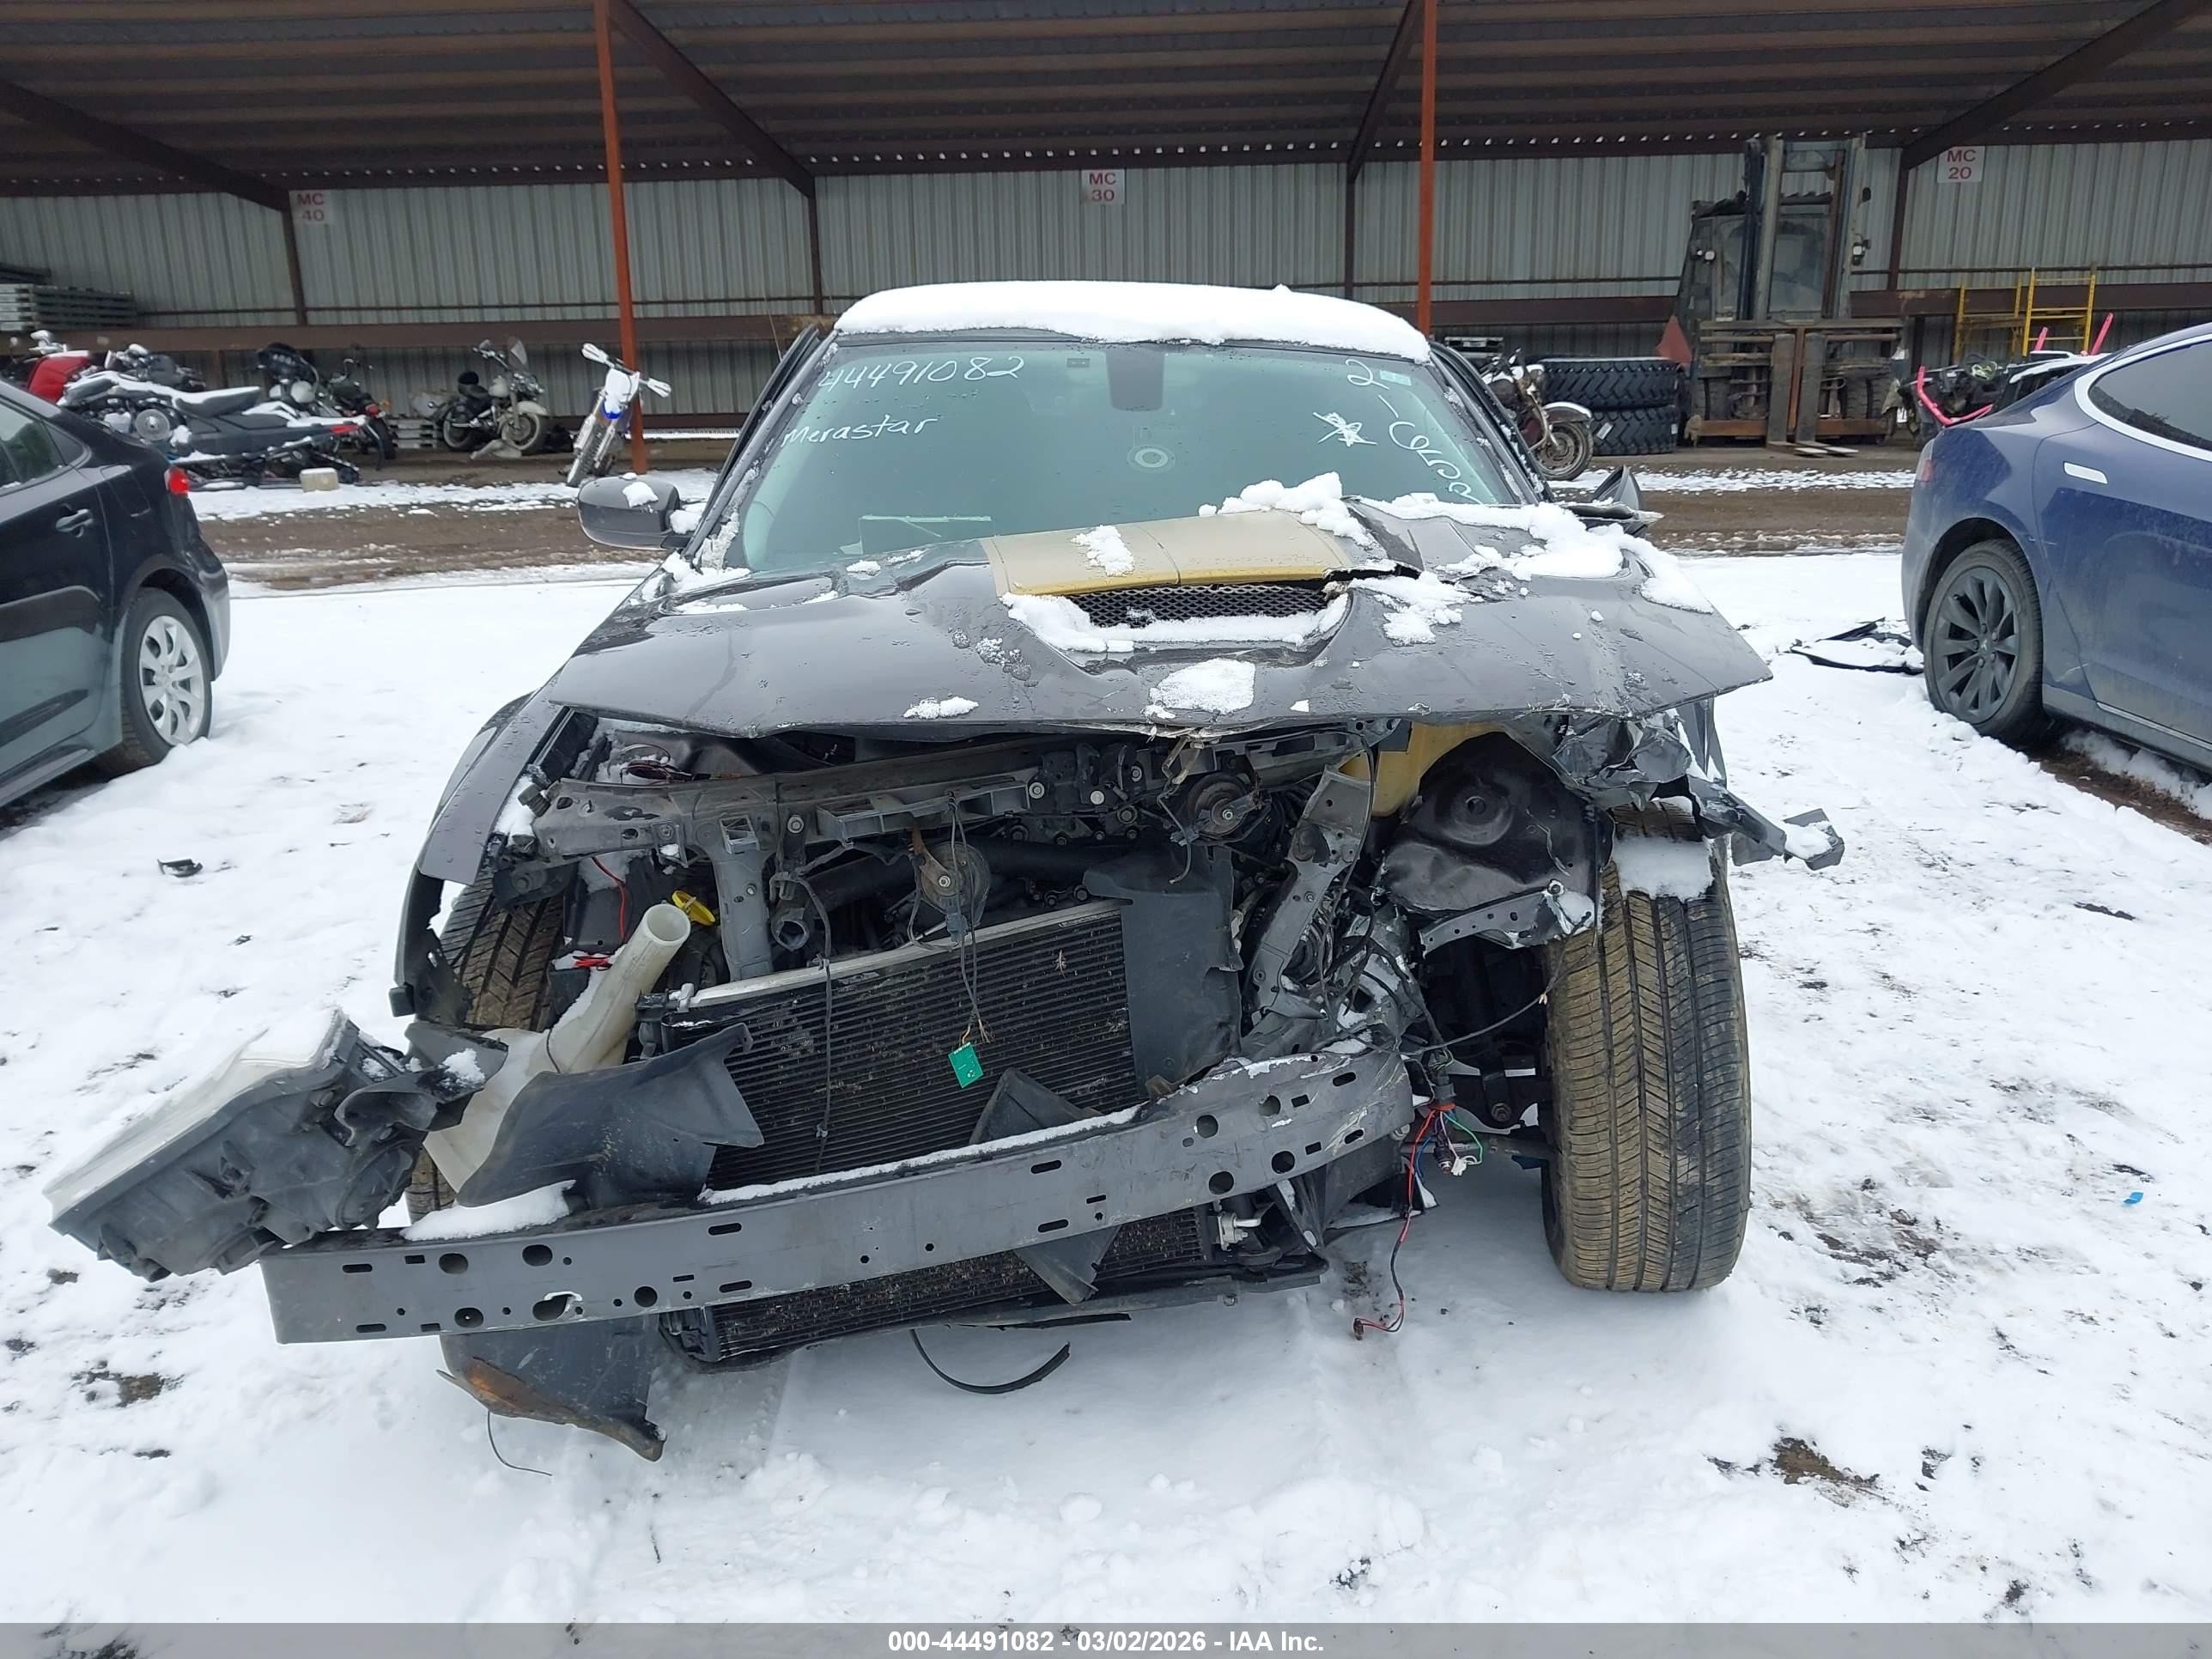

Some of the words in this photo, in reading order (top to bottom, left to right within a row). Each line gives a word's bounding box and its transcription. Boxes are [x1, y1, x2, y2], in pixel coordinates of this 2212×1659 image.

[1947, 149, 1977, 163] MC
[1089, 172, 1117, 185] MC
[1948, 167, 1972, 179] 20
[297, 192, 325, 206] MC
[1091, 189, 1115, 202] 30
[302, 209, 325, 222] 40
[817, 356, 1025, 392] 44491082
[781, 414, 939, 448] Merastar
